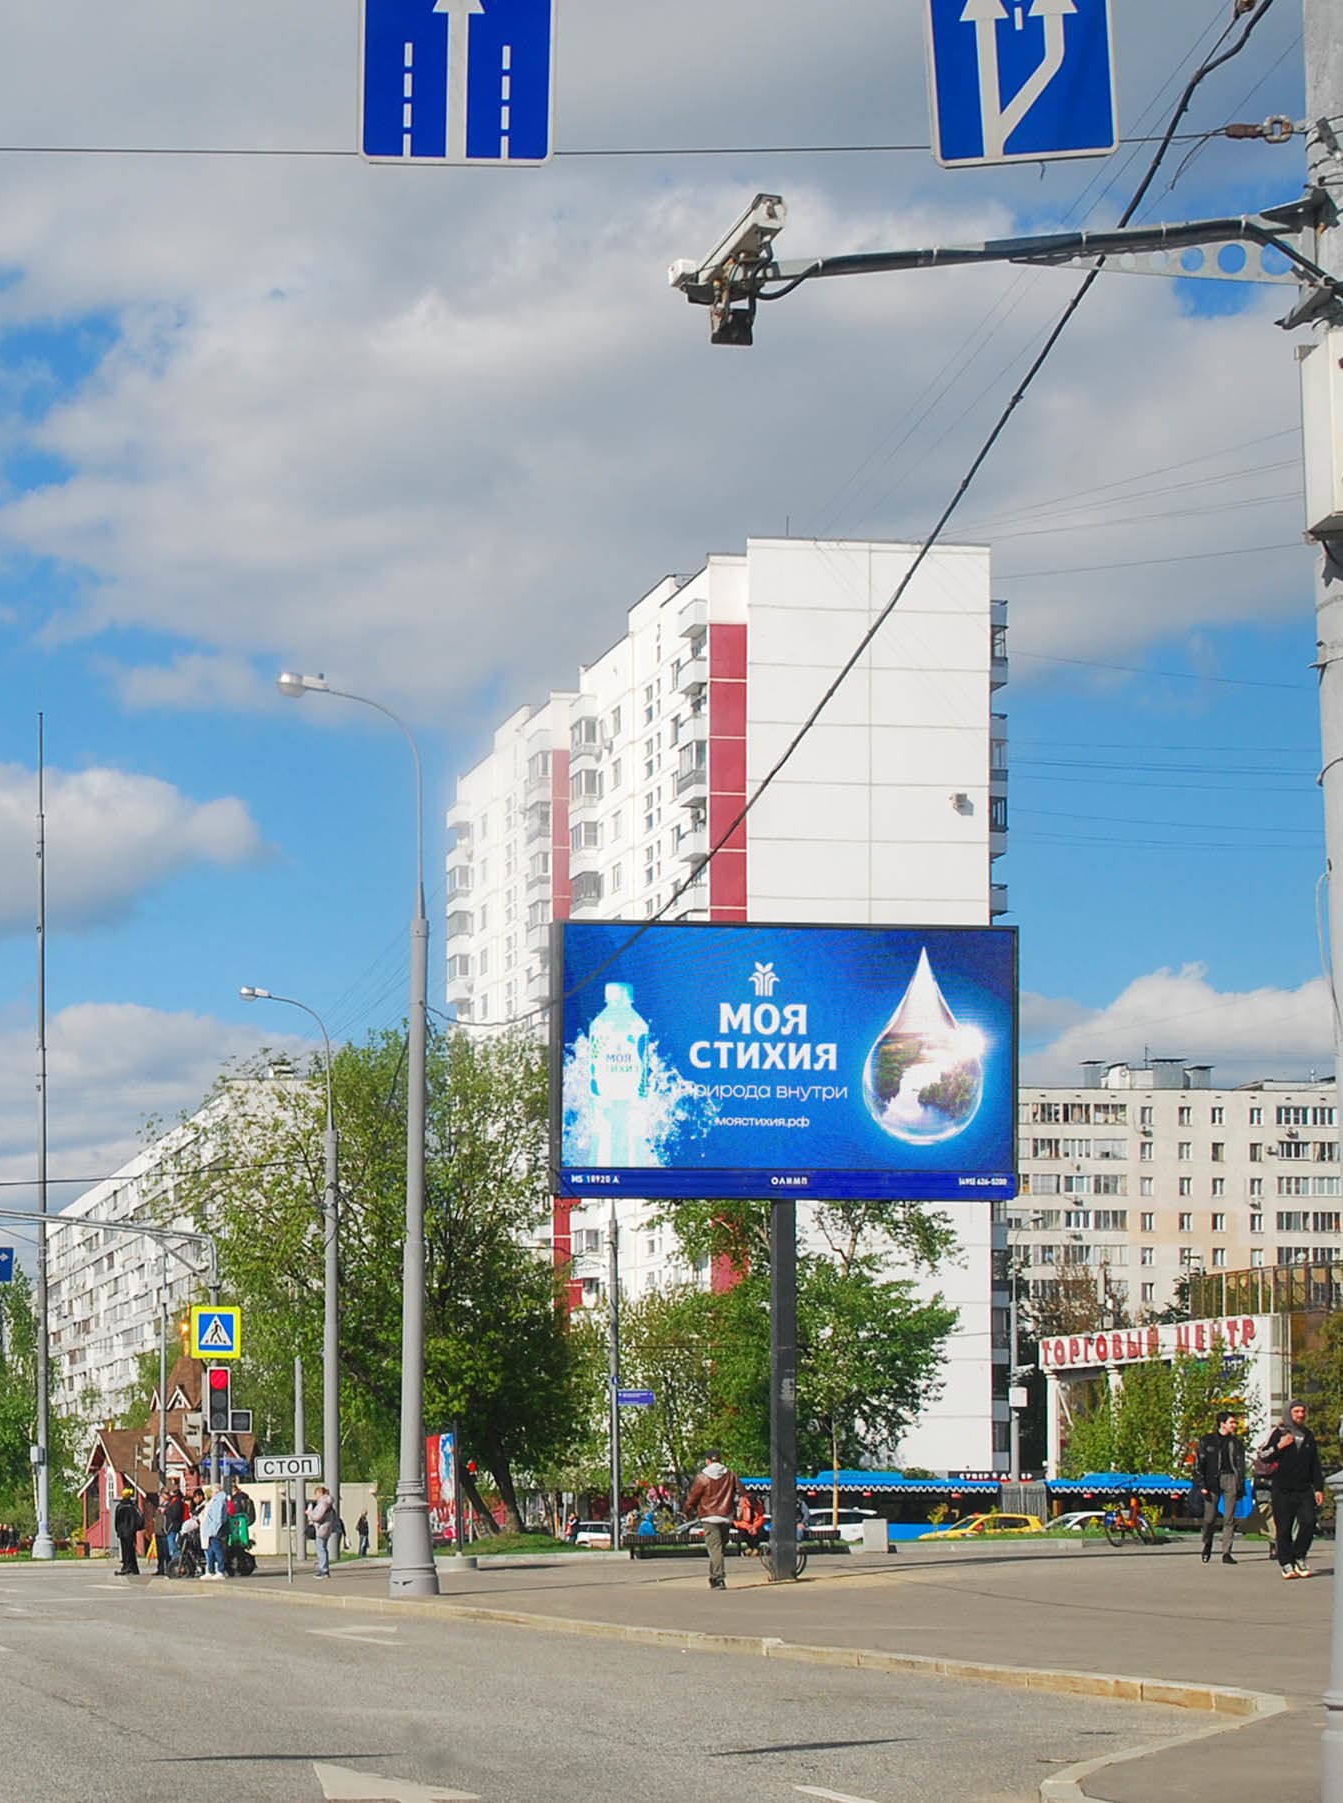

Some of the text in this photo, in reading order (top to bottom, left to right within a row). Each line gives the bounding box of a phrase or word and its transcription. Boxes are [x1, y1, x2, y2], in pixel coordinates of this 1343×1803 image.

[719, 1002, 808, 1035] МОЯ
[689, 1040, 837, 1071] СТИХИЯ
[776, 1084, 848, 1102] внутри
[715, 1116, 810, 1128] моястихия.рф
[770, 1176, 808, 1185] ОЛИМП
[1042, 1324, 1159, 1366] ТОРГОВЫЙ
[264, 1460, 312, 1475] СТОП
